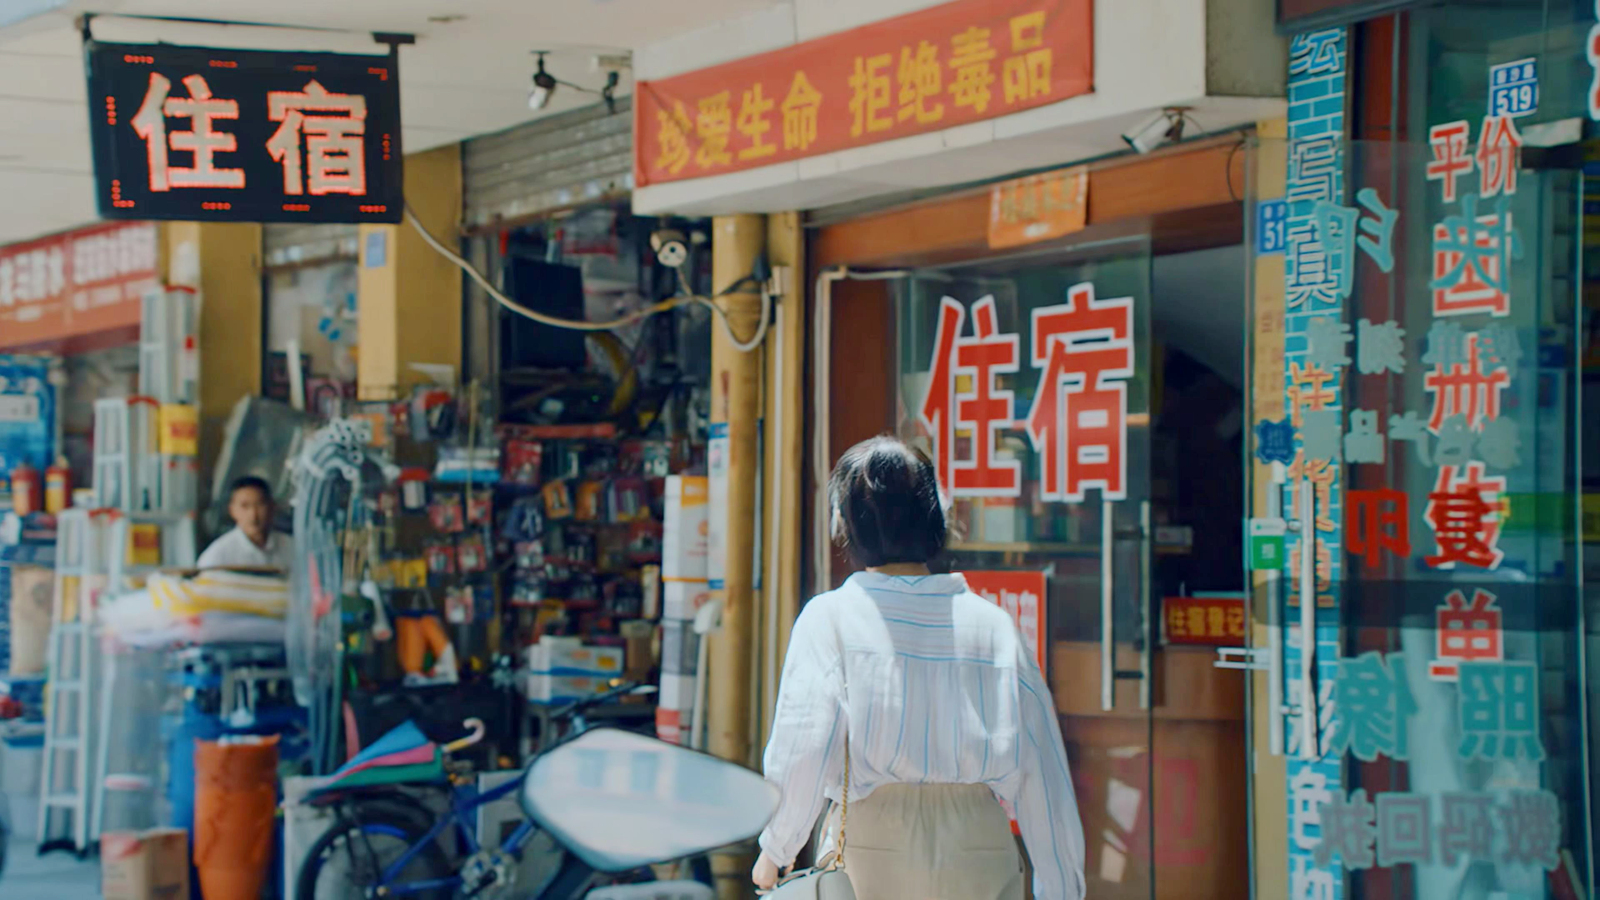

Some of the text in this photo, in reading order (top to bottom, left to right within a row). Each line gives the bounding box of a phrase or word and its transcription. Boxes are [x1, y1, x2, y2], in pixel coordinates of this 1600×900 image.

[130, 72, 367, 195] 住宿
[655, 10, 1054, 174] 珍爱生命 拒绝毒品
[1496, 85, 1532, 116] 519
[1427, 115, 1521, 202] 平价
[922, 282, 1135, 503] 住宿
